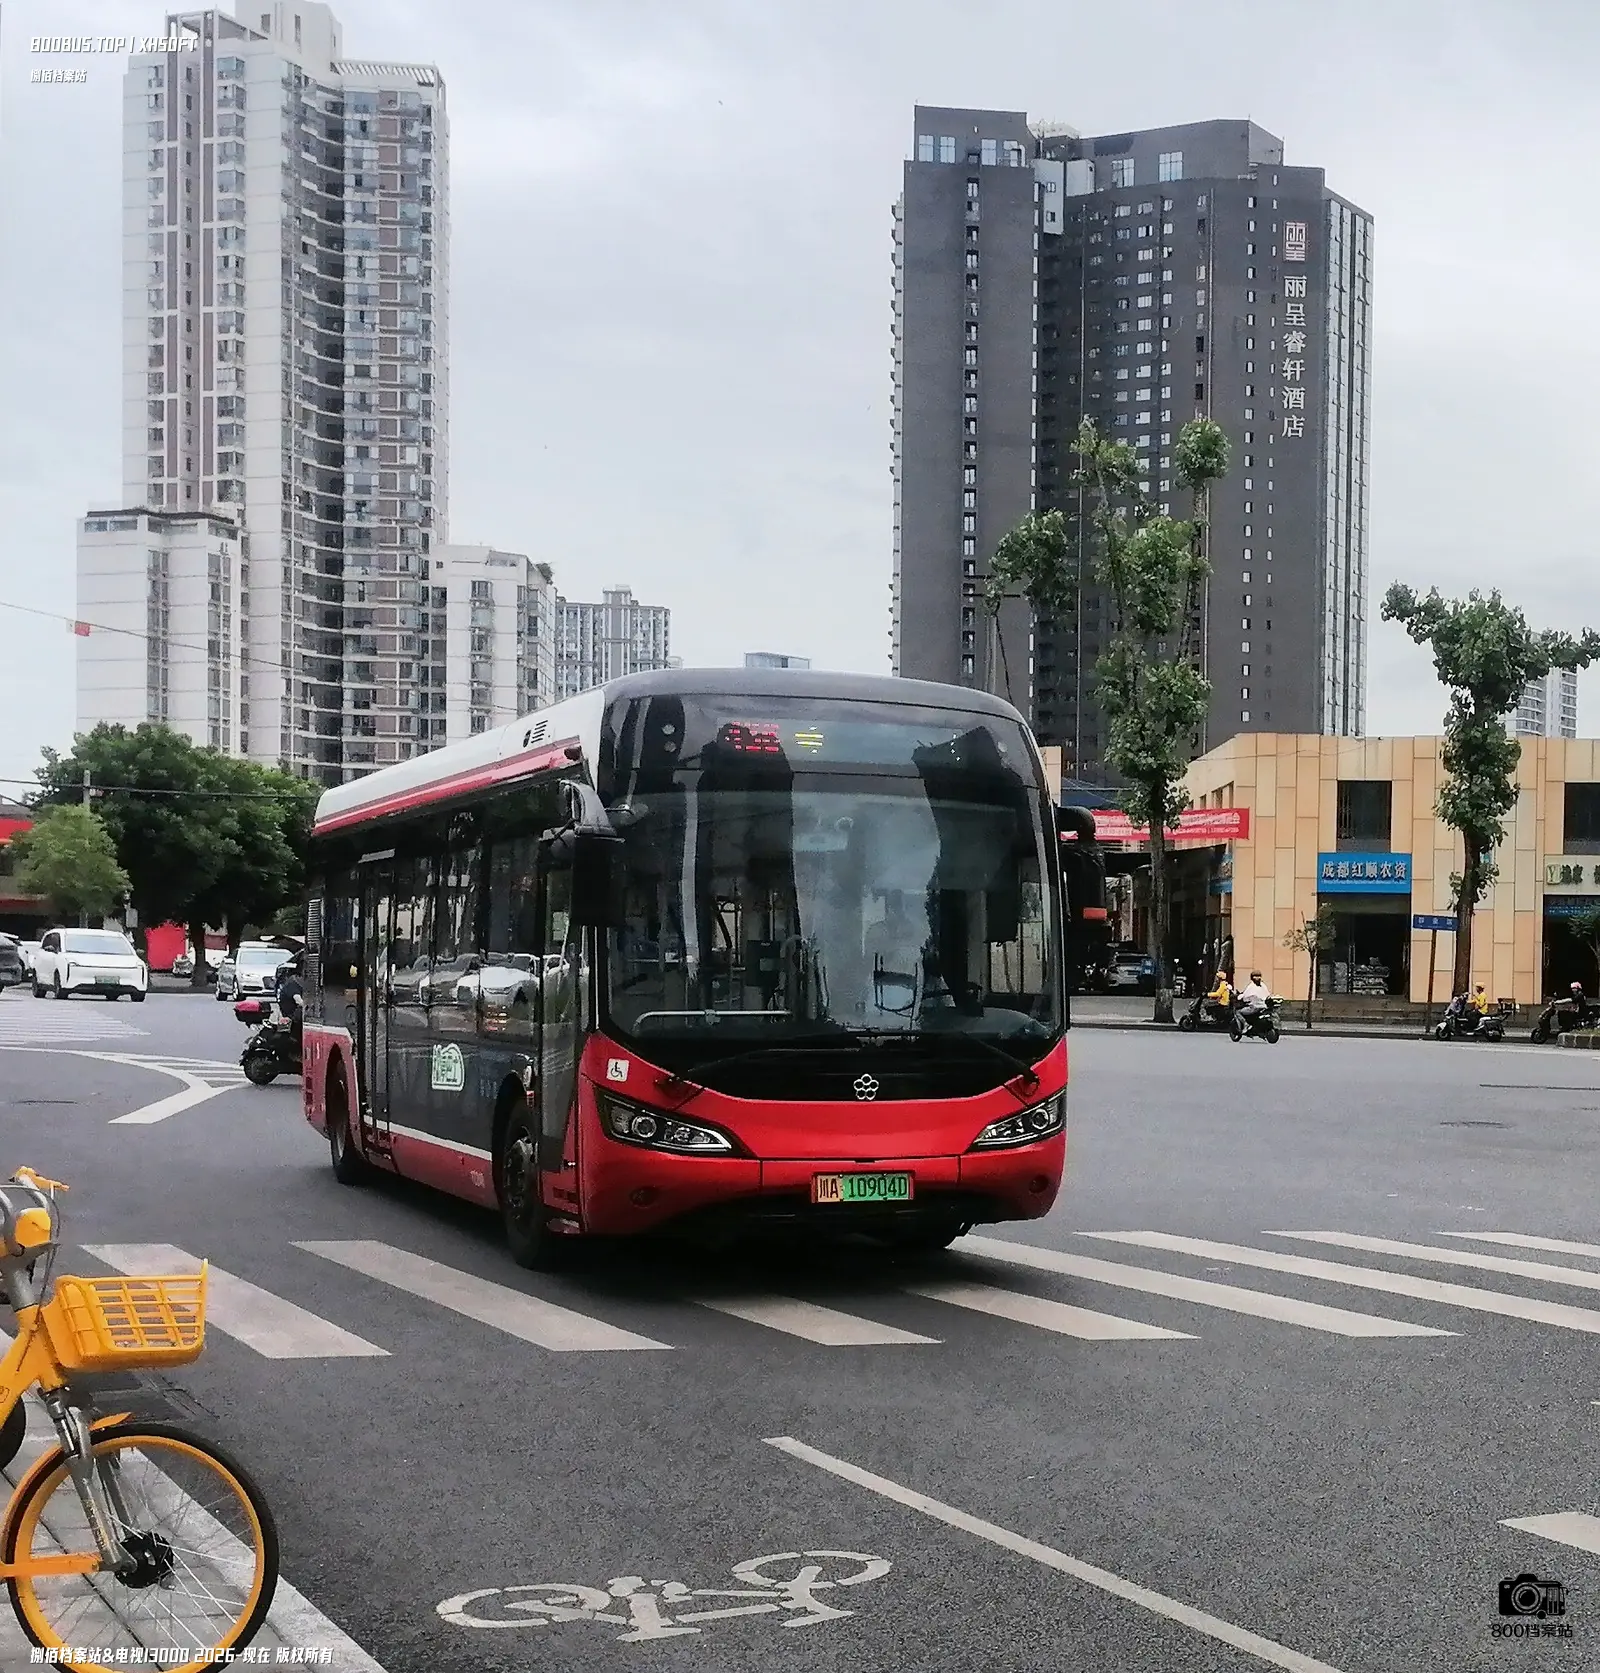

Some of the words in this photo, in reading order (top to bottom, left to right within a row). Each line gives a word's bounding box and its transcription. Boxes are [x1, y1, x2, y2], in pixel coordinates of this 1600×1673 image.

[1281, 275, 1307, 438] 丽呈睿轩酒店
[1322, 861, 1406, 879] 成都红顺农资
